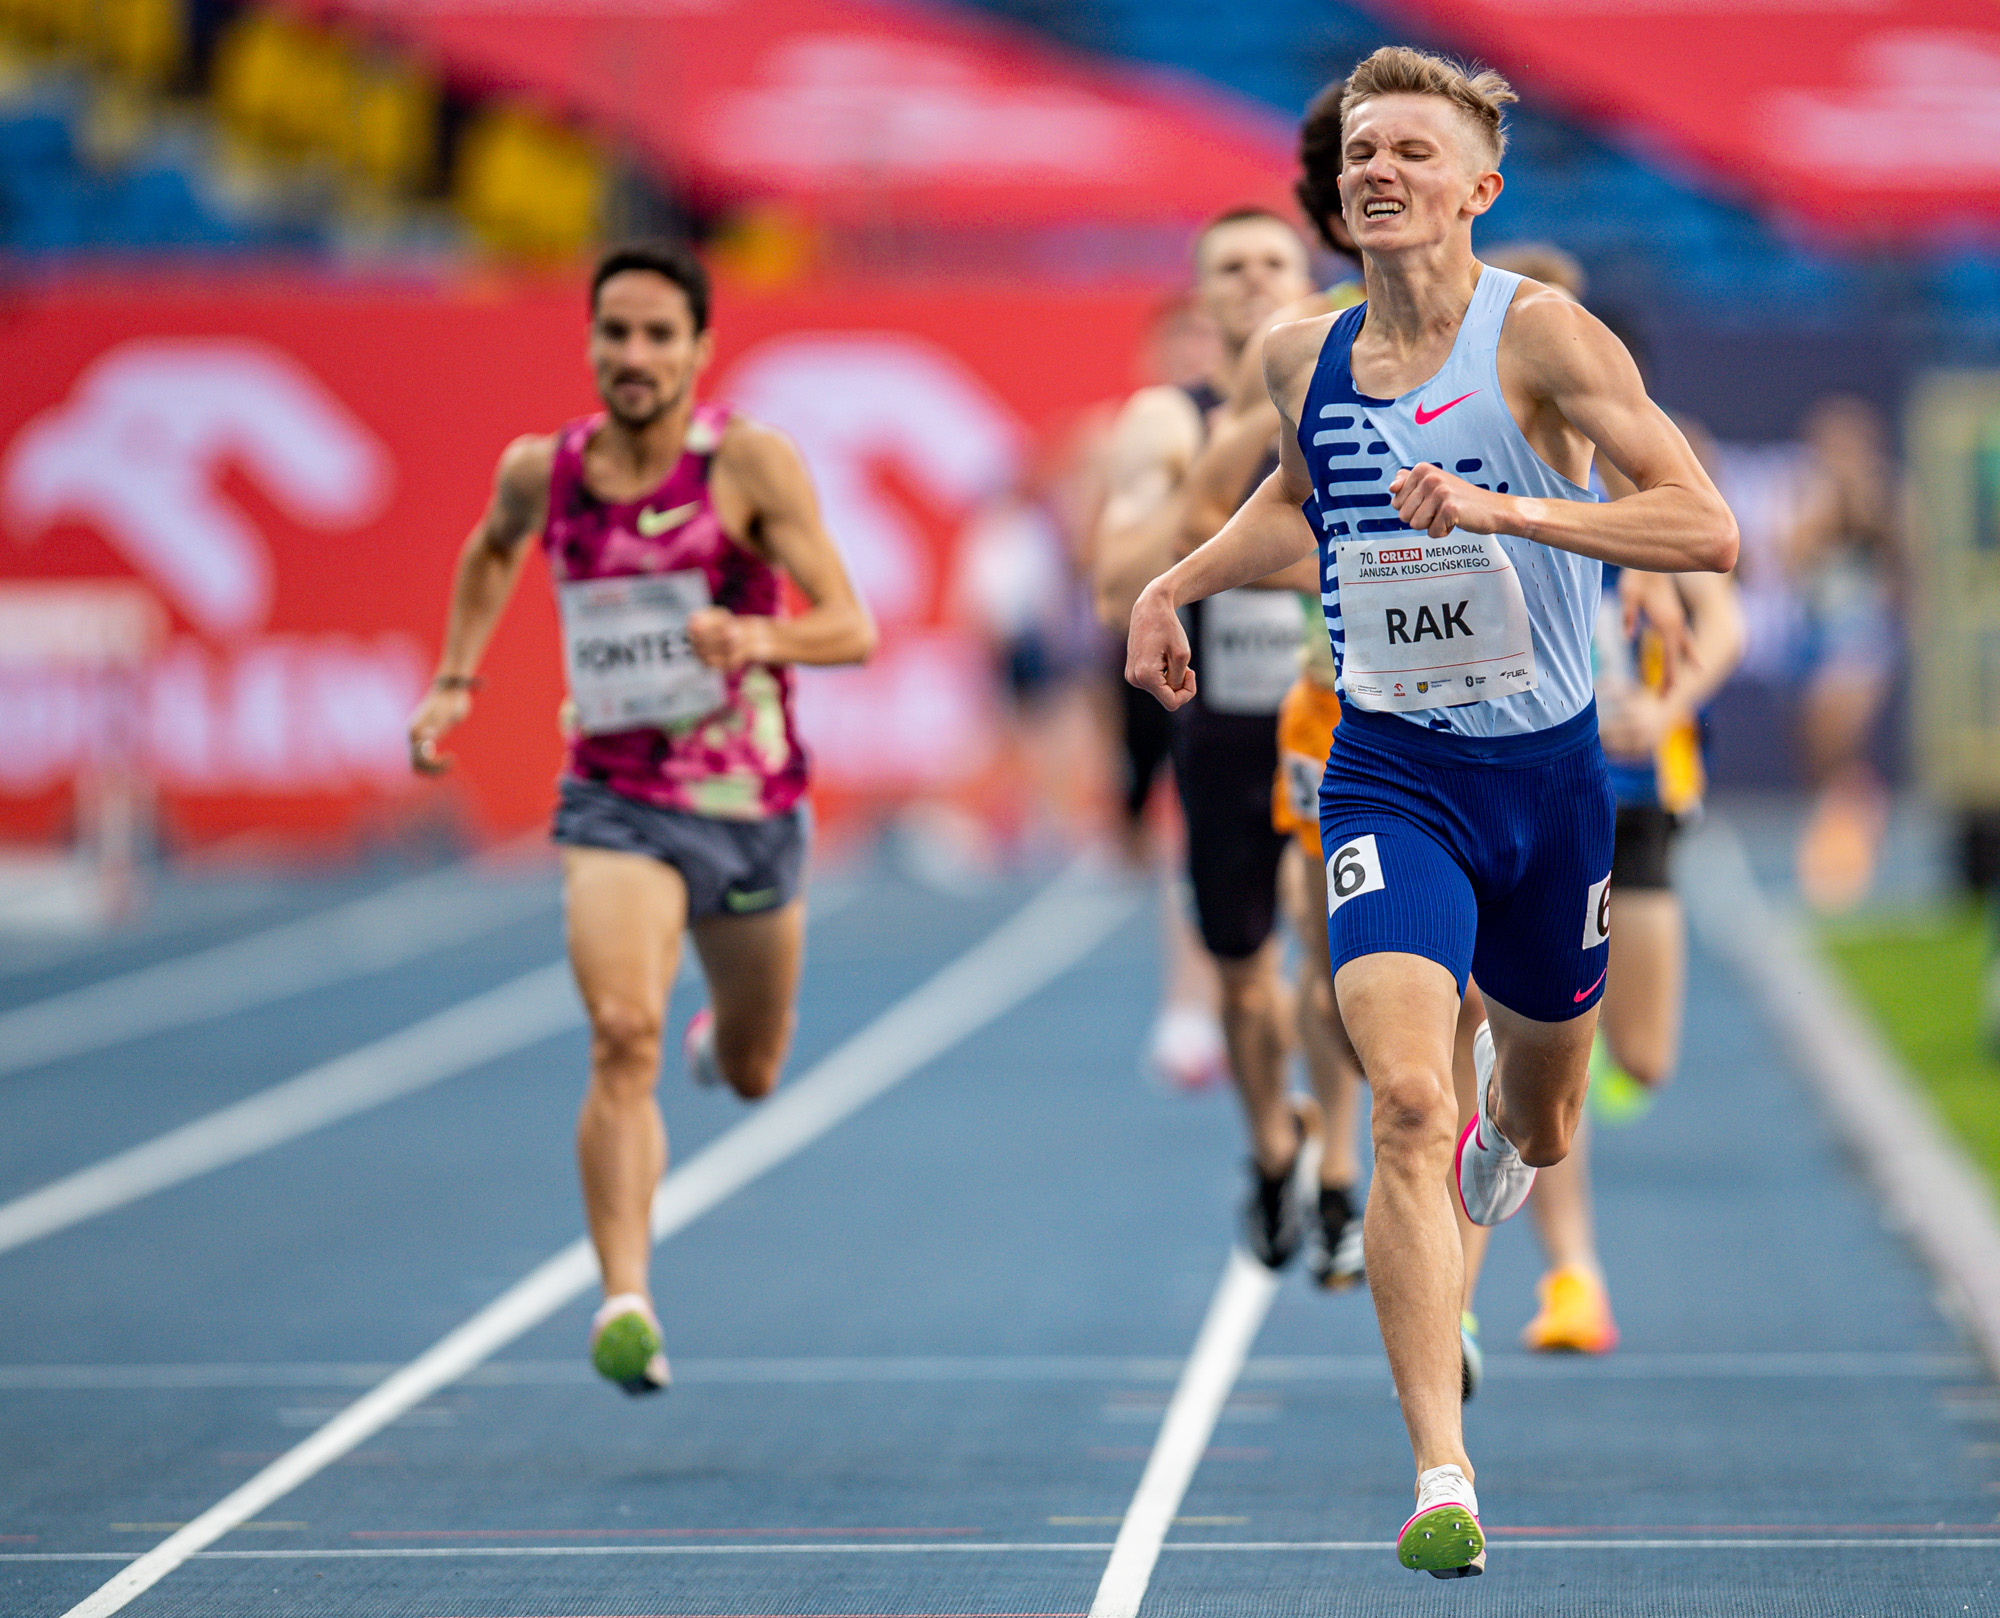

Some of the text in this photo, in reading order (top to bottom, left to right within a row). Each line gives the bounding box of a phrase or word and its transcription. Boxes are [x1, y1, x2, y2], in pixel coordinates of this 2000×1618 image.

[1359, 544, 1484, 565] 70. ORLEN MEMORIAŁ
[1359, 557, 1490, 578] JANUSZA KUSOCIŃSKIEGO
[1385, 600, 1474, 645] RAK
[1507, 668, 1528, 679] FUEL
[1333, 847, 1366, 898] 6
